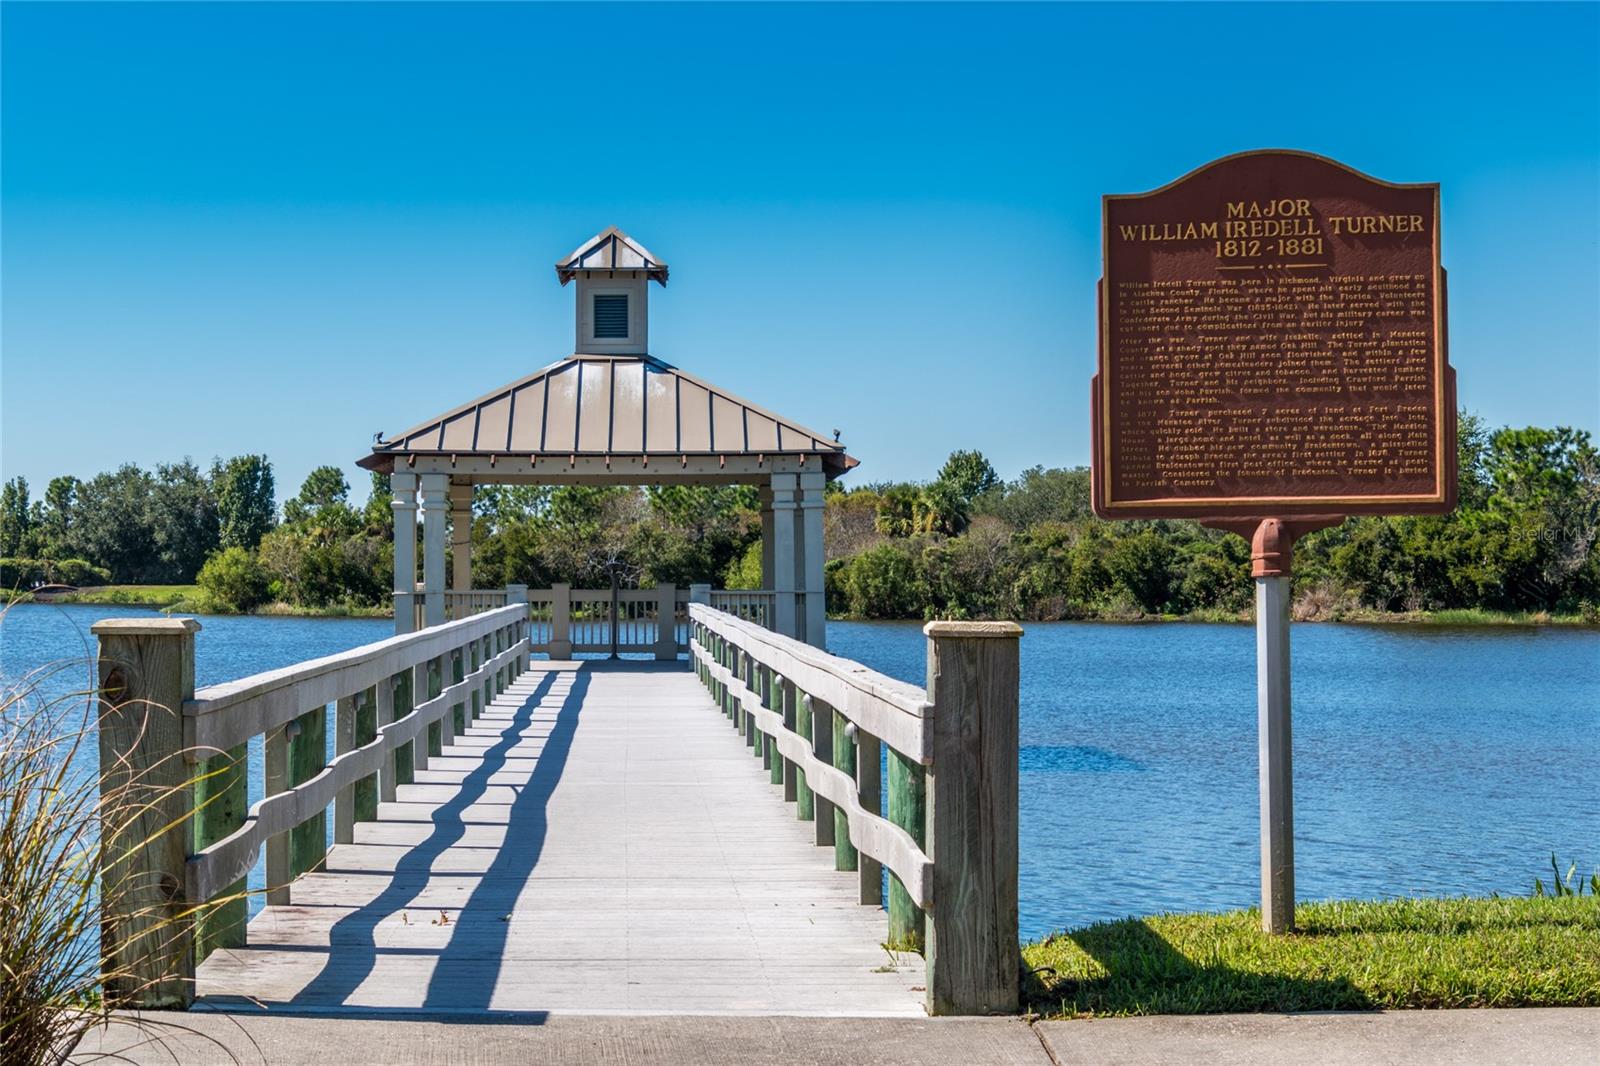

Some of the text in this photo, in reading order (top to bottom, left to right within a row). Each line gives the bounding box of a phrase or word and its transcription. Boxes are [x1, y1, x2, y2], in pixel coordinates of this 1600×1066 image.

[1227, 200, 1311, 218] MAJOR
[1119, 215, 1424, 241] WILLIAM IREDELL TURNER
